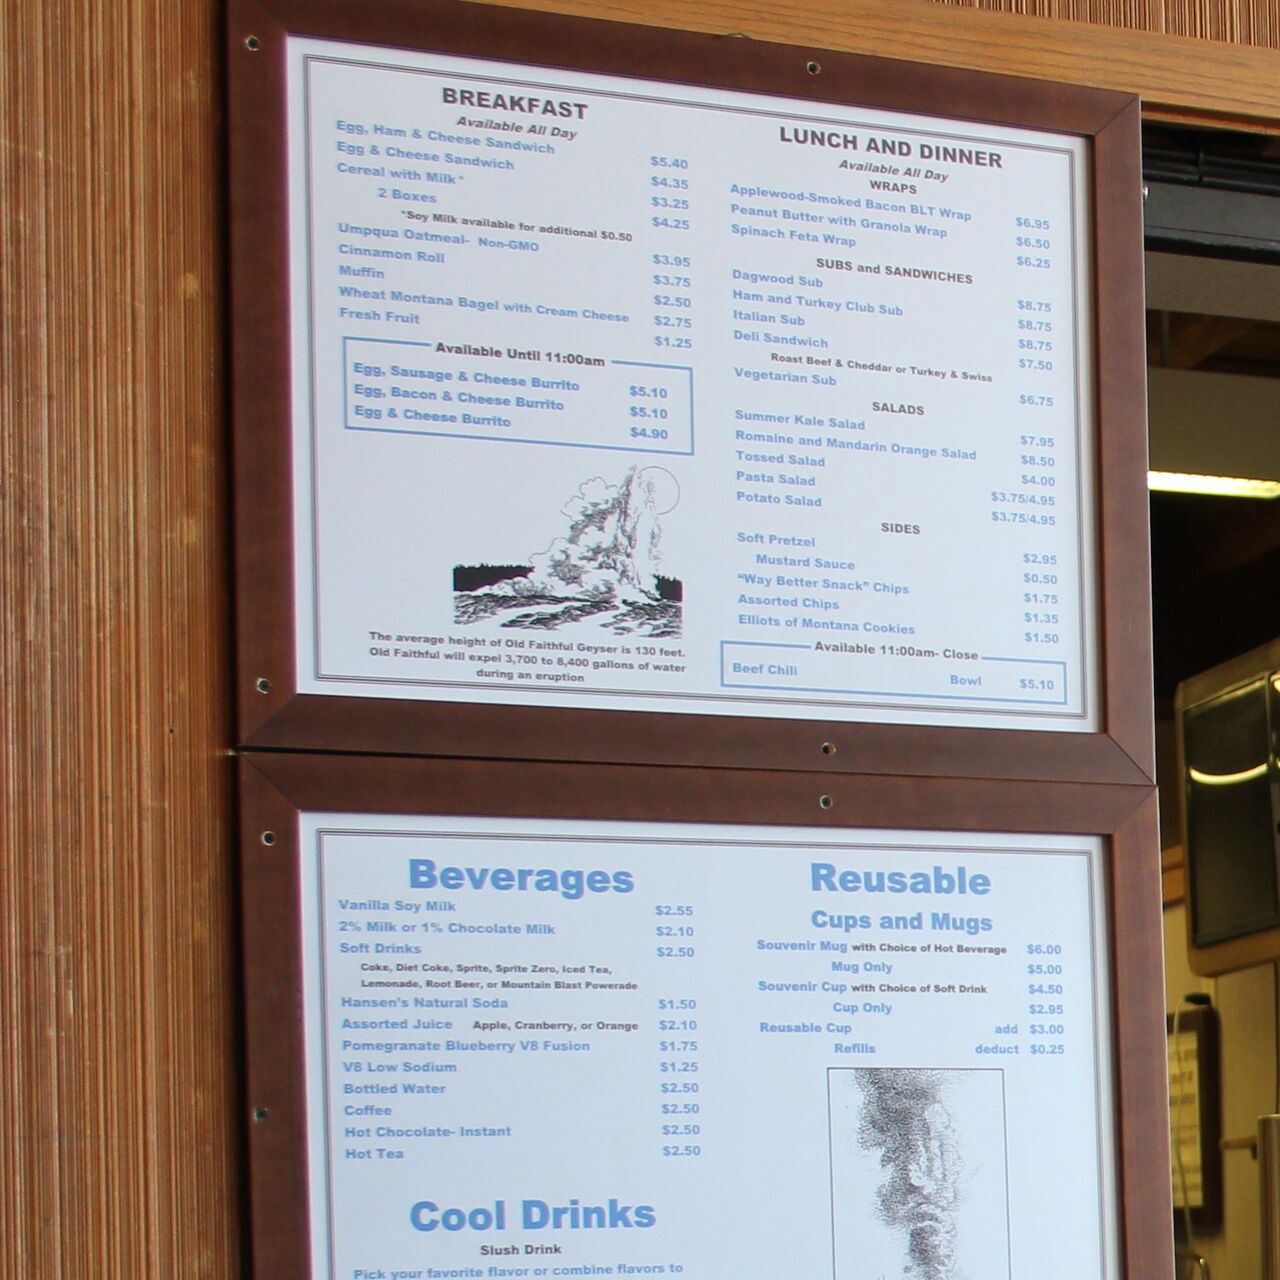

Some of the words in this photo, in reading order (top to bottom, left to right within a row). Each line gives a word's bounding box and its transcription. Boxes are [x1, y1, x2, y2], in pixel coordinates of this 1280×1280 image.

[442, 88, 588, 119] BREAKFAST
[456, 116, 523, 132] Available
[527, 124, 547, 135] All
[550, 127, 577, 140] Day
[336, 120, 368, 135] Egg,
[373, 124, 406, 137] Ham
[412, 128, 422, 139] &
[426, 131, 480, 145] Cheese
[486, 137, 554, 154] Sandwich
[650, 156, 688, 169] $5.40
[780, 126, 857, 150] LUNCH
[866, 138, 911, 156] AND
[920, 144, 1002, 168] DINNER
[869, 180, 916, 194] WRAPS
[731, 204, 778, 218] Peanut
[782, 209, 824, 222] Butter
[828, 216, 856, 226] with
[861, 218, 910, 232] Granola
[914, 224, 947, 239] Wrap
[1016, 236, 1050, 249] $6.50
[338, 222, 398, 238] Umpqua
[478, 237, 539, 251] Non-GMO
[652, 254, 690, 267] $3.95
[731, 224, 784, 238] Spinach
[789, 230, 818, 242] Feta
[822, 234, 856, 248] Wrap
[1016, 256, 1050, 268] $6.25
[338, 244, 412, 260] Cinnamon
[416, 251, 444, 263] Roll
[653, 274, 690, 287] $3.75
[816, 258, 852, 270] SUBS
[857, 264, 880, 274] and
[885, 266, 972, 284] SANDWICHES
[338, 265, 384, 278] Muffin
[653, 295, 691, 308] $2.50
[732, 269, 794, 284] Dagwood
[798, 276, 822, 287] Sub
[1017, 300, 1051, 312] $8.75
[339, 286, 386, 300] Wheat
[390, 290, 453, 306] Montana
[458, 297, 498, 311] Bagel
[503, 303, 532, 312] with
[536, 305, 578, 317] Cream
[582, 309, 629, 322] Cheese
[654, 315, 691, 328] $2.75
[339, 307, 380, 320] Fresh
[384, 311, 420, 324] Fruit
[654, 336, 692, 348] $1.25
[733, 310, 776, 322] Italian
[780, 314, 805, 326] Sub
[1018, 338, 1052, 351] $8.75
[435, 342, 502, 358] Available
[507, 348, 540, 360] Until
[546, 352, 604, 366] 11:00am
[353, 384, 386, 398] Egg,
[390, 386, 436, 400] Bacon
[442, 391, 452, 401] &
[458, 392, 510, 406] Cheese
[516, 397, 564, 410] Burrito
[872, 402, 924, 415] SALADS
[735, 410, 790, 423] Summer
[794, 415, 824, 426] Kale
[828, 418, 865, 430] Salad
[1020, 435, 1054, 447] $7.95
[736, 450, 784, 463] Tossed
[788, 454, 825, 466] Salad
[1022, 474, 1055, 486] $4.00
[881, 522, 920, 534] SIDES
[756, 554, 810, 566] Mustard
[814, 558, 854, 570] Sauce
[1024, 572, 1057, 584] $0.50
[738, 594, 798, 606] Assorted
[802, 598, 839, 611] Chips
[1024, 612, 1058, 624] $1.35
[476, 669, 513, 680] during
[536, 673, 584, 682] eruption
[732, 662, 764, 674] Beef
[768, 665, 797, 676] Chili
[950, 674, 981, 686] Bowl
[1020, 678, 1054, 690] $5.10
[409, 859, 634, 900] Beverages
[811, 863, 990, 895] Reusable
[338, 900, 389, 910] Vanilla
[394, 900, 421, 913] Soy
[426, 901, 455, 911] Milk
[655, 905, 693, 916] $2.55
[811, 910, 871, 933] Cups
[880, 912, 922, 930] and
[931, 912, 992, 935] Mugs
[339, 943, 370, 953] Soft
[374, 943, 421, 954] Drinks
[656, 947, 694, 957] $2.50
[832, 961, 859, 974] Mug
[863, 962, 892, 974] Only
[1028, 964, 1062, 975] $5.00
[340, 997, 408, 1008] Hansen's
[414, 997, 468, 1008] Natural
[472, 998, 508, 1008] Soda
[342, 1040, 441, 1053] Pomegranate
[445, 1040, 515, 1053] Blueberry
[520, 1040, 538, 1051] V8
[544, 1041, 590, 1051] Fusion
[660, 1041, 698, 1052] $1.75
[343, 1084, 397, 1094] Bottled
[402, 1084, 446, 1094] Water
[344, 1105, 392, 1116] Coffee
[410, 1200, 505, 1232] Cool
[522, 1199, 656, 1230] Drinks
[480, 1245, 519, 1256] Slush
[524, 1244, 561, 1254] Drink
